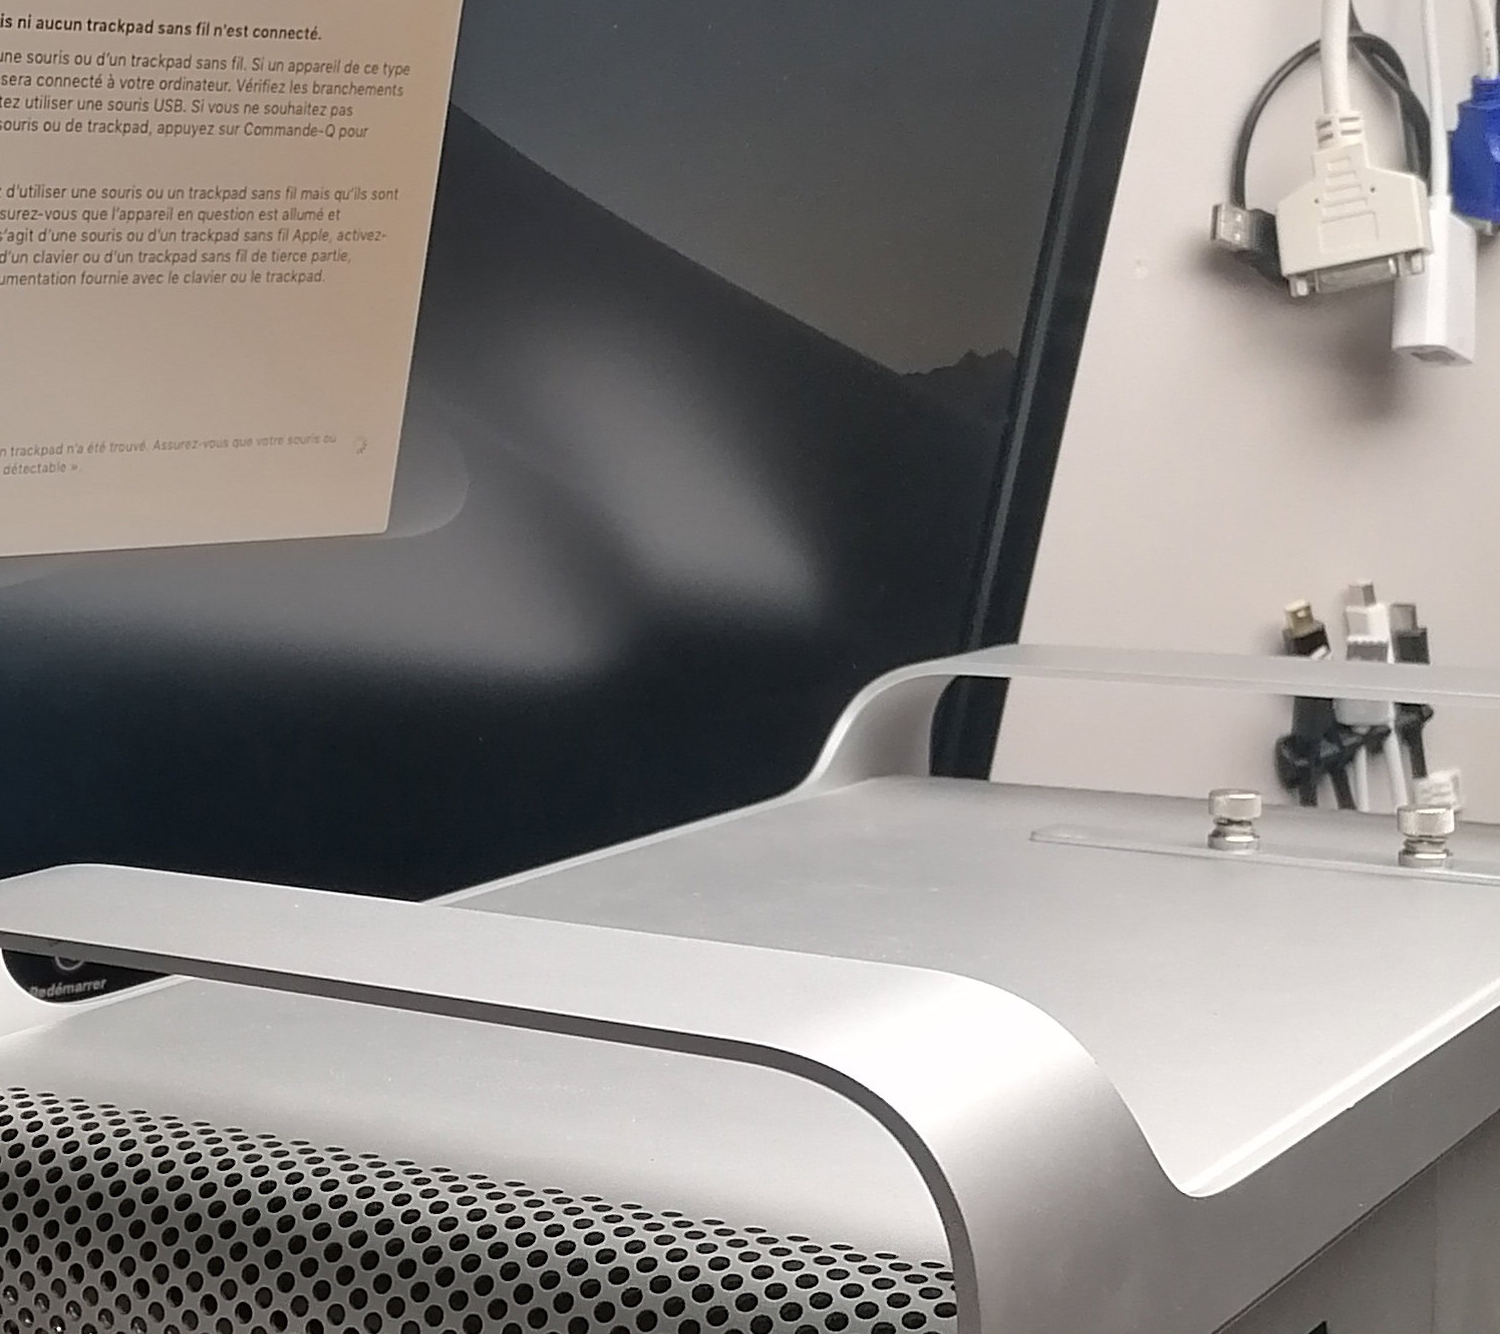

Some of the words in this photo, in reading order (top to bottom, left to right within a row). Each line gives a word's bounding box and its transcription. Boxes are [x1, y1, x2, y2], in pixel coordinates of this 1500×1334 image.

[17, 13, 32, 29] ni
[35, 18, 83, 32] aucun
[86, 18, 155, 37] trackpad
[157, 23, 192, 36] sans
[195, 21, 211, 36] fil
[252, 26, 322, 41] connecté.
[26, 49, 70, 66] souris
[73, 54, 93, 66] ou
[130, 53, 193, 71] trackpad
[195, 58, 227, 71] sans
[231, 55, 247, 71] fil.
[251, 56, 265, 72] Si
[267, 60, 285, 72] un
[287, 59, 341, 75] appareil
[343, 59, 360, 75] de
[363, 63, 380, 75] ce
[382, 62, 411, 78] type
[0, 74, 32, 87] sera
[35, 73, 103, 89] connecté
[106, 73, 116, 90] à
[119, 76, 155, 91] votre
[158, 76, 232, 93] ordinateur.
[236, 78, 286, 94] Vérifiez
[289, 79, 309, 95] les
[312, 80, 404, 97] branchements
[24, 94, 74, 111] utiliser
[76, 99, 104, 112] une
[107, 97, 150, 112] souris
[153, 97, 187, 113] USB.
[190, 98, 205, 114] Si
[207, 102, 240, 115] vous
[243, 103, 260, 115] ne
[263, 101, 328, 117] souhaitez
[330, 105, 354, 119] pas
[42, 120, 61, 133] ou
[64, 117, 83, 133] de
[87, 118, 153, 137] trackpad,
[156, 123, 215, 139] appuyez
[218, 124, 241, 136] sur
[243, 121, 336, 139] Commande-Q
[338, 126, 369, 140] pour
[70, 187, 97, 200] une
[101, 185, 143, 200] souris
[146, 188, 164, 200] ou
[167, 188, 185, 200] un
[188, 185, 248, 203] trackpad
[250, 189, 282, 200] sans
[285, 186, 298, 200] fil
[300, 187, 330, 201] mais
[371, 188, 399, 201] sont
[81, 209, 108, 224] que
[177, 210, 194, 221] en
[197, 206, 255, 224] question
[258, 208, 279, 221] est
[281, 207, 324, 222] allumé
[327, 208, 341, 221] et
[80, 227, 123, 243] souris
[126, 231, 145, 243] ou
[180, 227, 240, 244] trackpad
[243, 230, 274, 243] sans
[277, 228, 290, 242] fil
[291, 228, 332, 244] Apple,
[336, 229, 387, 242] activez-
[32, 249, 80, 264] clavier
[82, 252, 101, 264] ou
[138, 248, 198, 266] trackpad
[200, 252, 232, 263] sans
[235, 248, 248, 263] fil
[250, 249, 268, 263] de
[271, 250, 308, 263] tierce
[310, 248, 351, 265] partie,
[80, 270, 129, 285] fournie
[131, 273, 164, 285] avec
[167, 270, 180, 285] le
[183, 269, 227, 284] clavier
[229, 272, 247, 284] ou
[250, 269, 262, 284] le
[265, 269, 326, 285] trackpad.
[10, 442, 64, 458] trackpad
[152, 438, 229, 451] Assurez-vous
[231, 437, 253, 449] que
[255, 435, 285, 447] votre
[287, 433, 320, 445] souris
[322, 434, 337, 444] ou
[2, 461, 67, 476] détectable
[30, 979, 107, 998] Redémarrer
